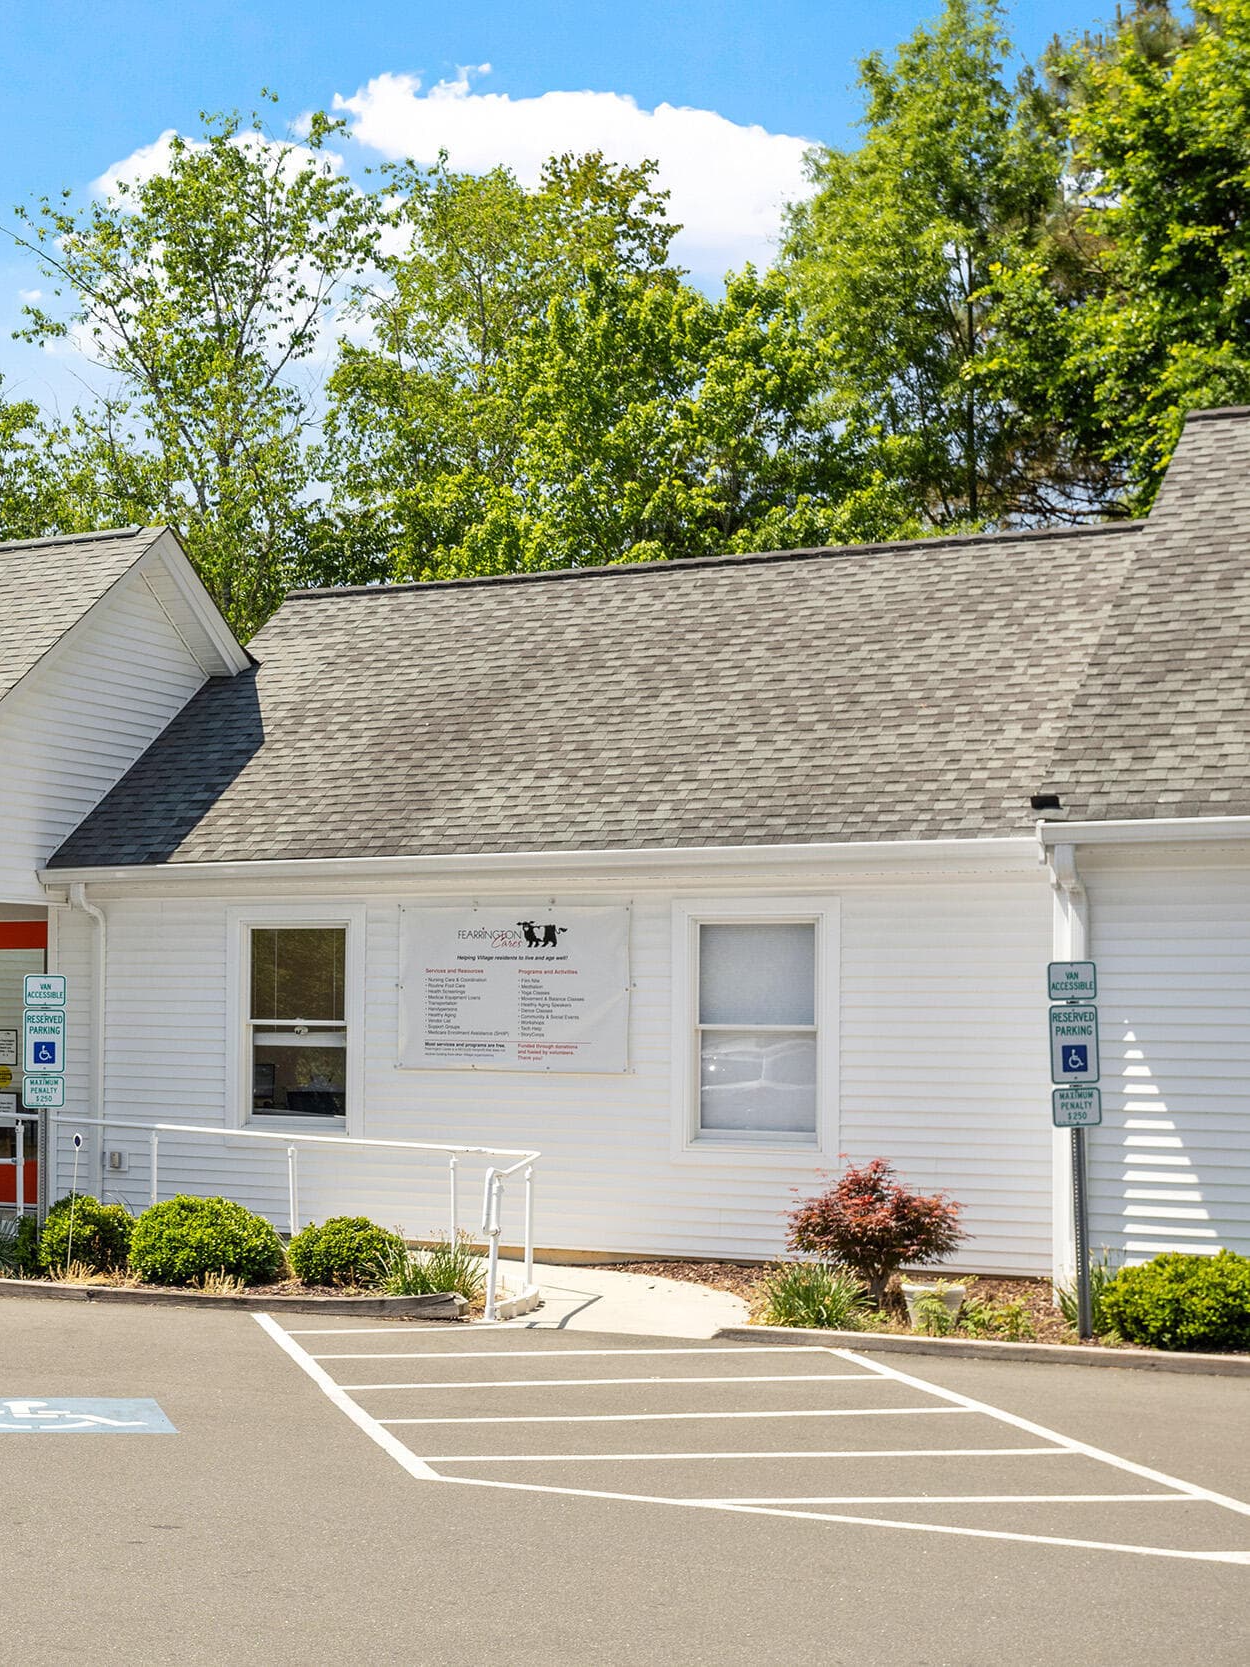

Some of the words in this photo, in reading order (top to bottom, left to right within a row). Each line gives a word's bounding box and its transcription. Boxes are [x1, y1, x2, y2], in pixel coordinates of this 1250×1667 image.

[458, 929, 522, 939] FEARRINGTON
[491, 932, 522, 948] Cares
[1065, 972, 1078, 980] VAN
[1052, 981, 1094, 991] ACCESSIBLE
[27, 1015, 62, 1024] RESERVED
[1052, 1012, 1094, 1022] RESERVED
[30, 1026, 60, 1034] PARKING
[1056, 1026, 1092, 1036] PARKING
[1060, 1092, 1093, 1100] MAXIMUM
[1061, 1101, 1092, 1110] PENALTY
[1068, 1112, 1087, 1120] $250
